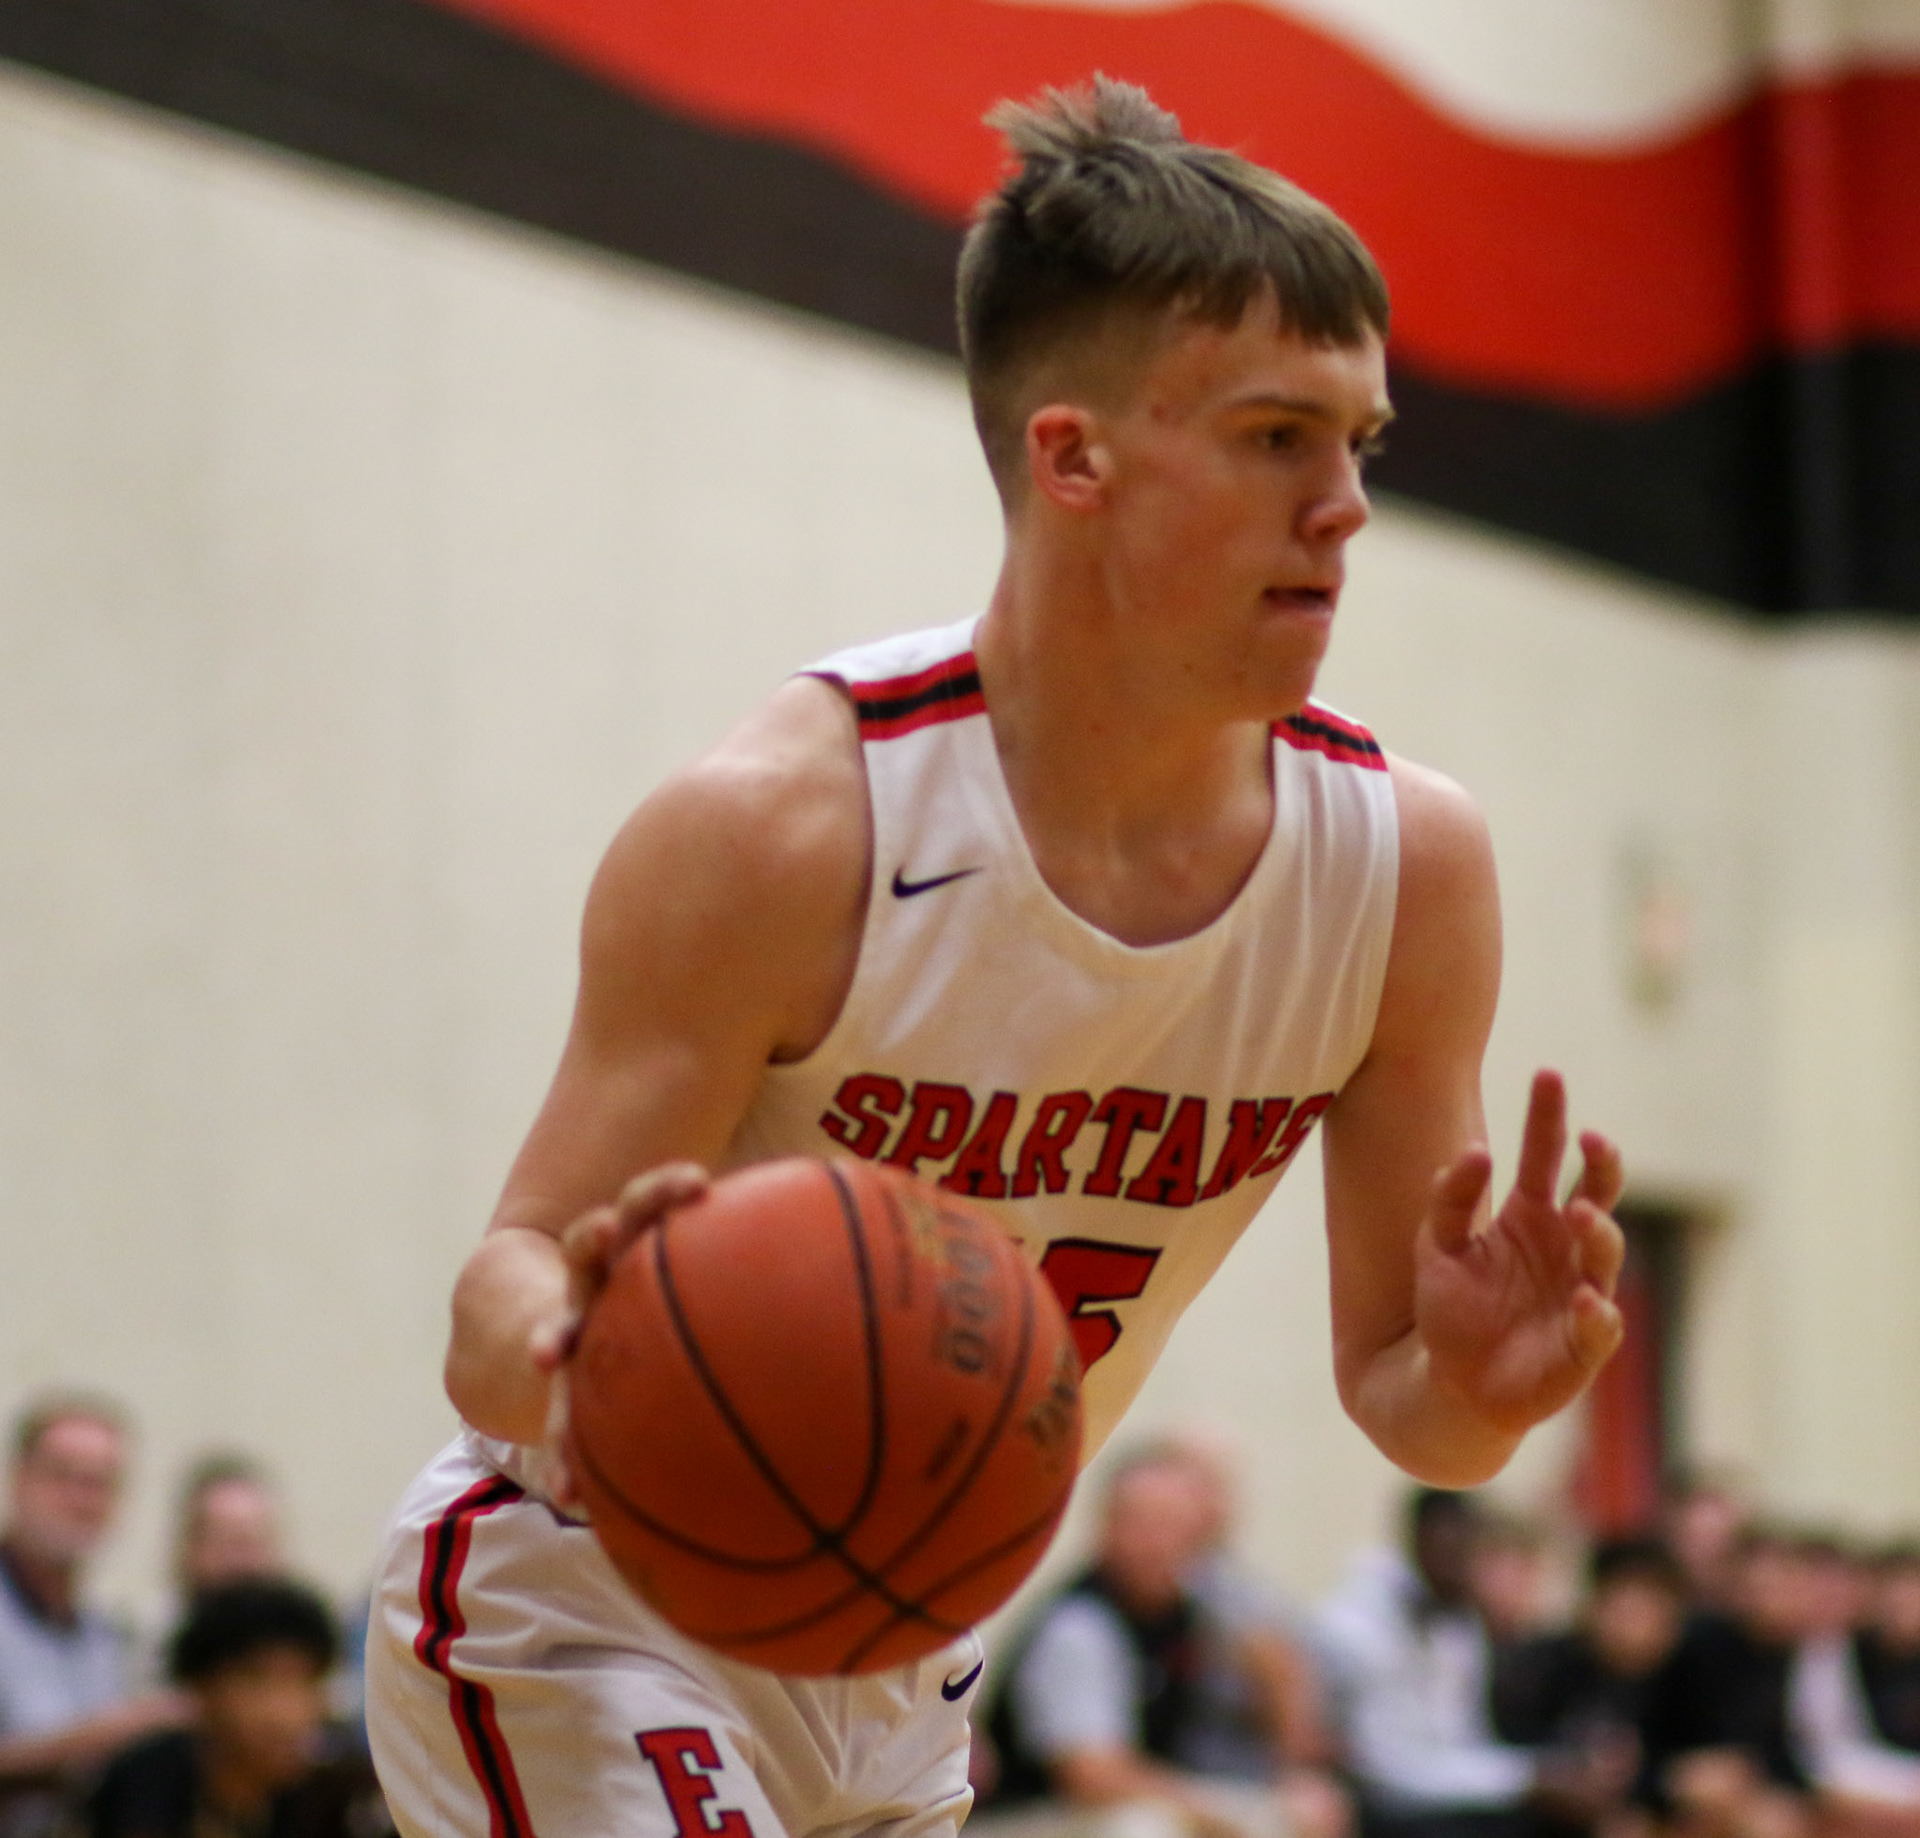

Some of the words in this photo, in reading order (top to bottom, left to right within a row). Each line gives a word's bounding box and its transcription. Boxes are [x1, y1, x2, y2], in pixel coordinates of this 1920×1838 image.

[819, 1072, 1336, 1208] SPARTANS
[1010, 1236, 1165, 1384] 5
[634, 1725, 756, 1838] E
